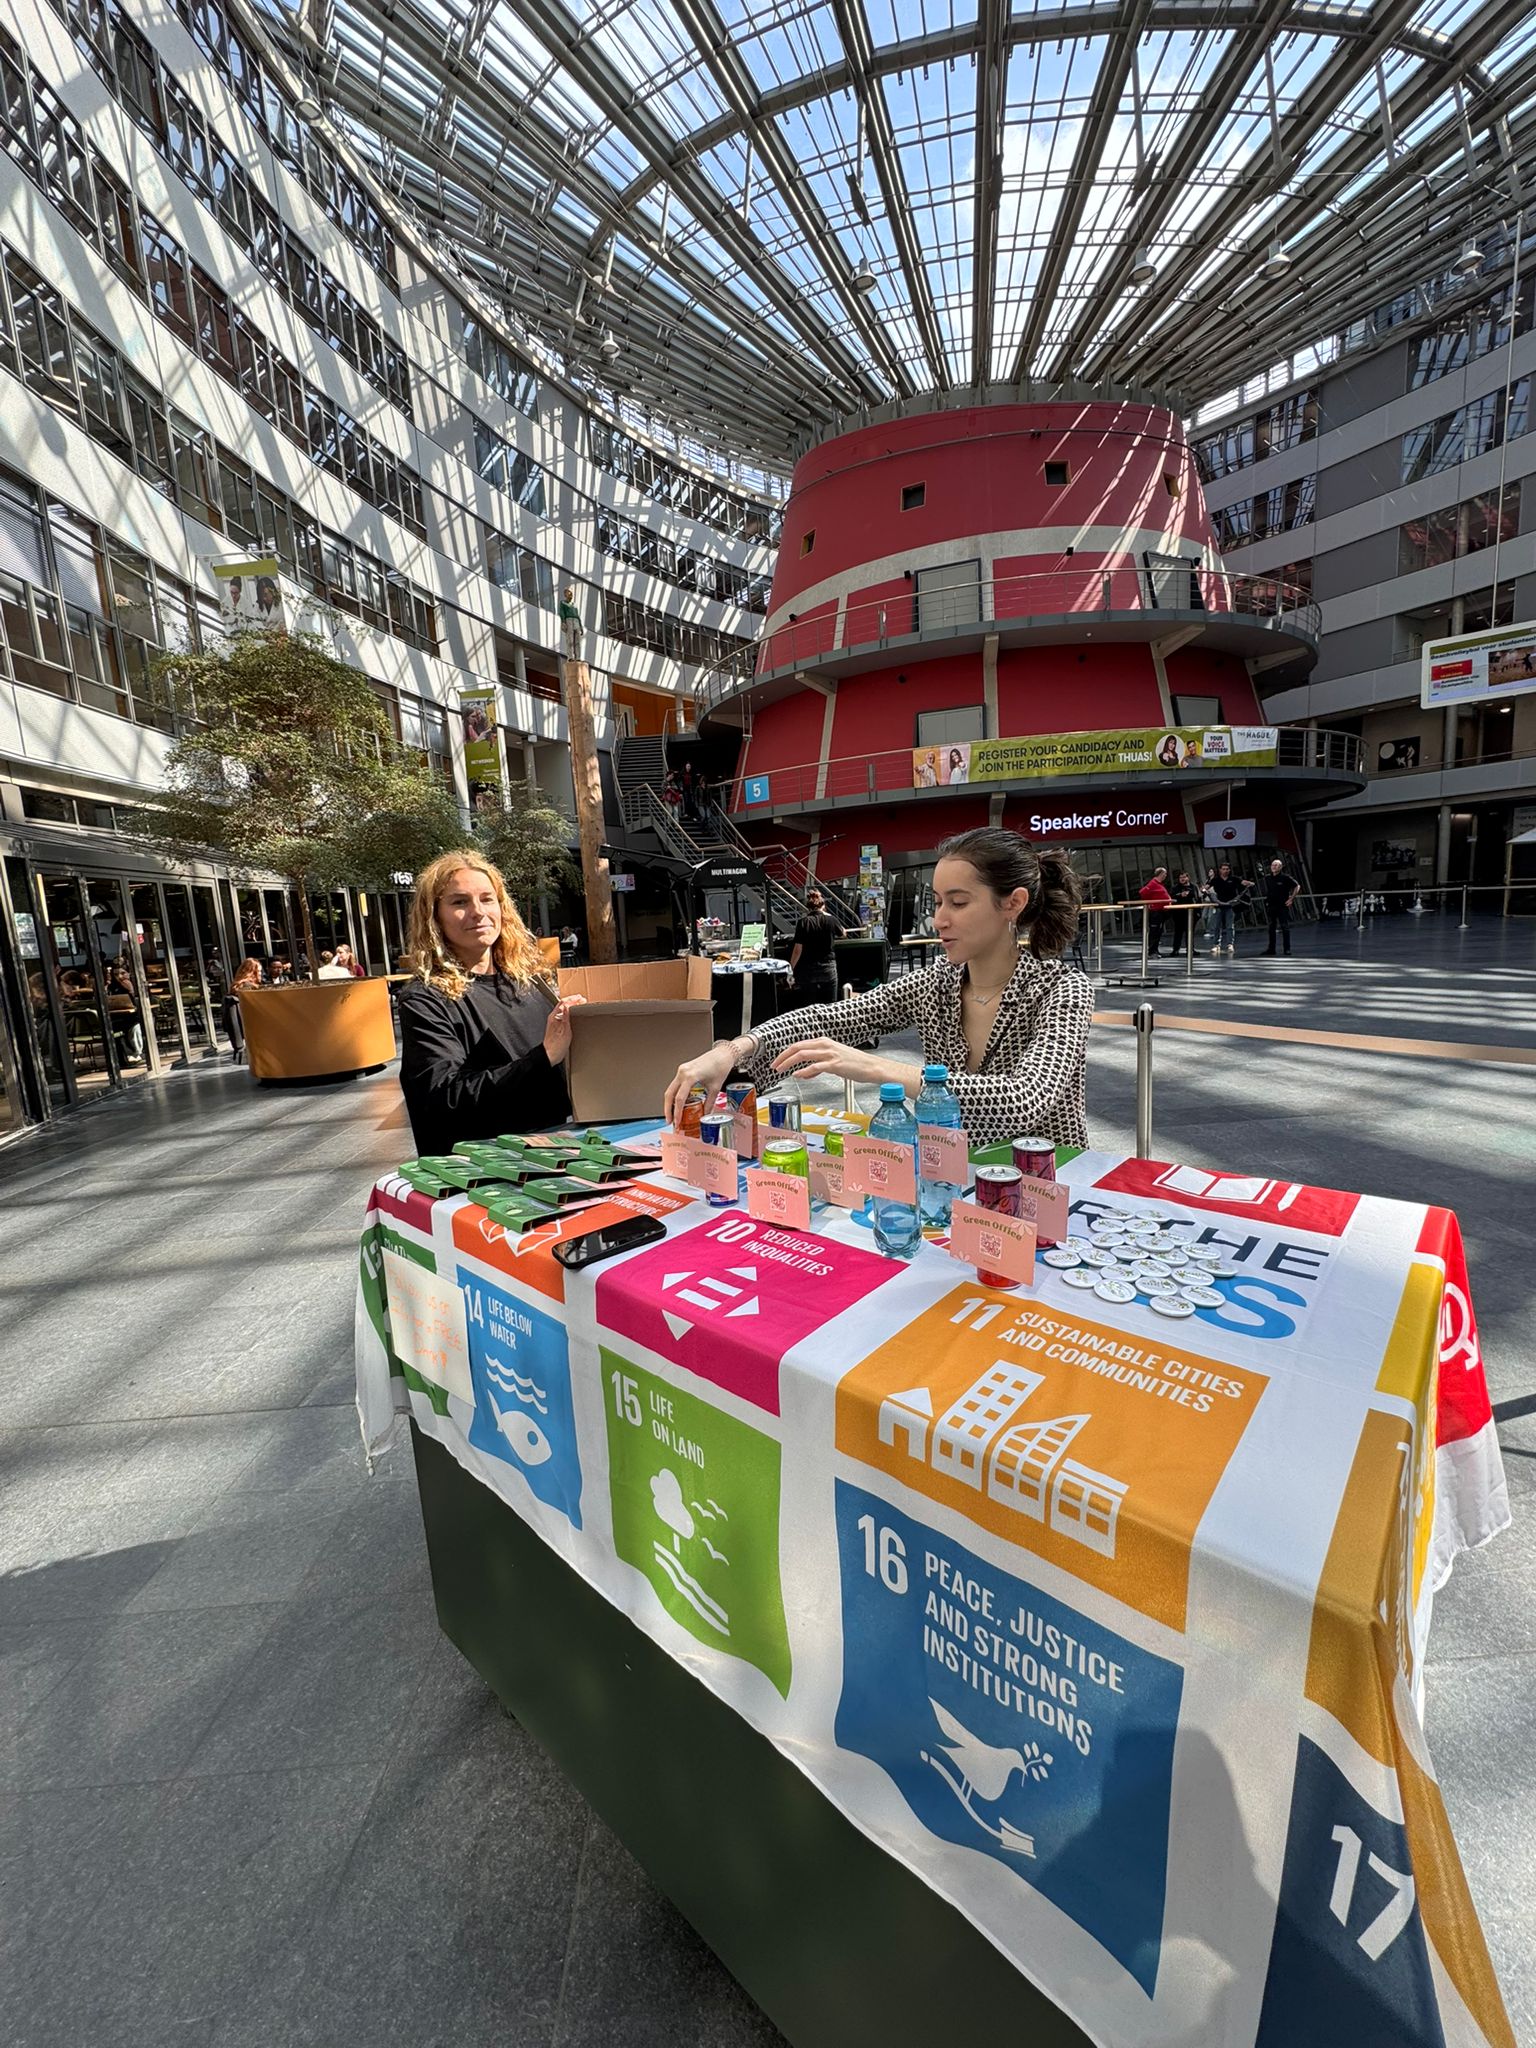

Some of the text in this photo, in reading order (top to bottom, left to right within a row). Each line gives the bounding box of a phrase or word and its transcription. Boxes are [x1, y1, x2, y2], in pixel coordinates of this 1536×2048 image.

[978, 739, 1145, 761] REGISTER YOUR CANDIDACY AND
[1246, 731, 1271, 739] HAGUE
[978, 751, 1152, 773] JOIN THE PARTICIPATION AT THUAS!
[753, 783, 762, 798] 5
[1116, 810, 1168, 827] Corner
[853, 1147, 903, 1164] Green Office
[931, 1134, 957, 1148] Office
[711, 1151, 730, 1165] Office
[756, 1179, 799, 1194] Green Office
[1028, 1184, 1056, 1202] Office
[704, 1218, 757, 1243] 10
[759, 1229, 826, 1256] REDUCED
[963, 1215, 1022, 1241] Green Office
[740, 1240, 834, 1276] INEQUALITIES
[464, 1284, 484, 1329] 14
[488, 1296, 532, 1338] LIFE BELOW
[950, 1297, 1006, 1331] 11
[489, 1319, 517, 1350] WATER
[997, 1328, 1215, 1413] AND COMMUNITIES
[1014, 1311, 1246, 1399] SUSTAINABLE CITIES
[612, 1370, 643, 1427] 15
[649, 1389, 674, 1423] LIFE
[652, 1419, 705, 1469] ON LAND
[857, 1513, 909, 1595] 16
[925, 1551, 1125, 1694] PEACE, JUSTICE
[925, 1591, 1079, 1708] AND STRONG
[923, 1624, 1093, 1756] INSTITUTIONS
[1329, 1824, 1414, 1962] 17
